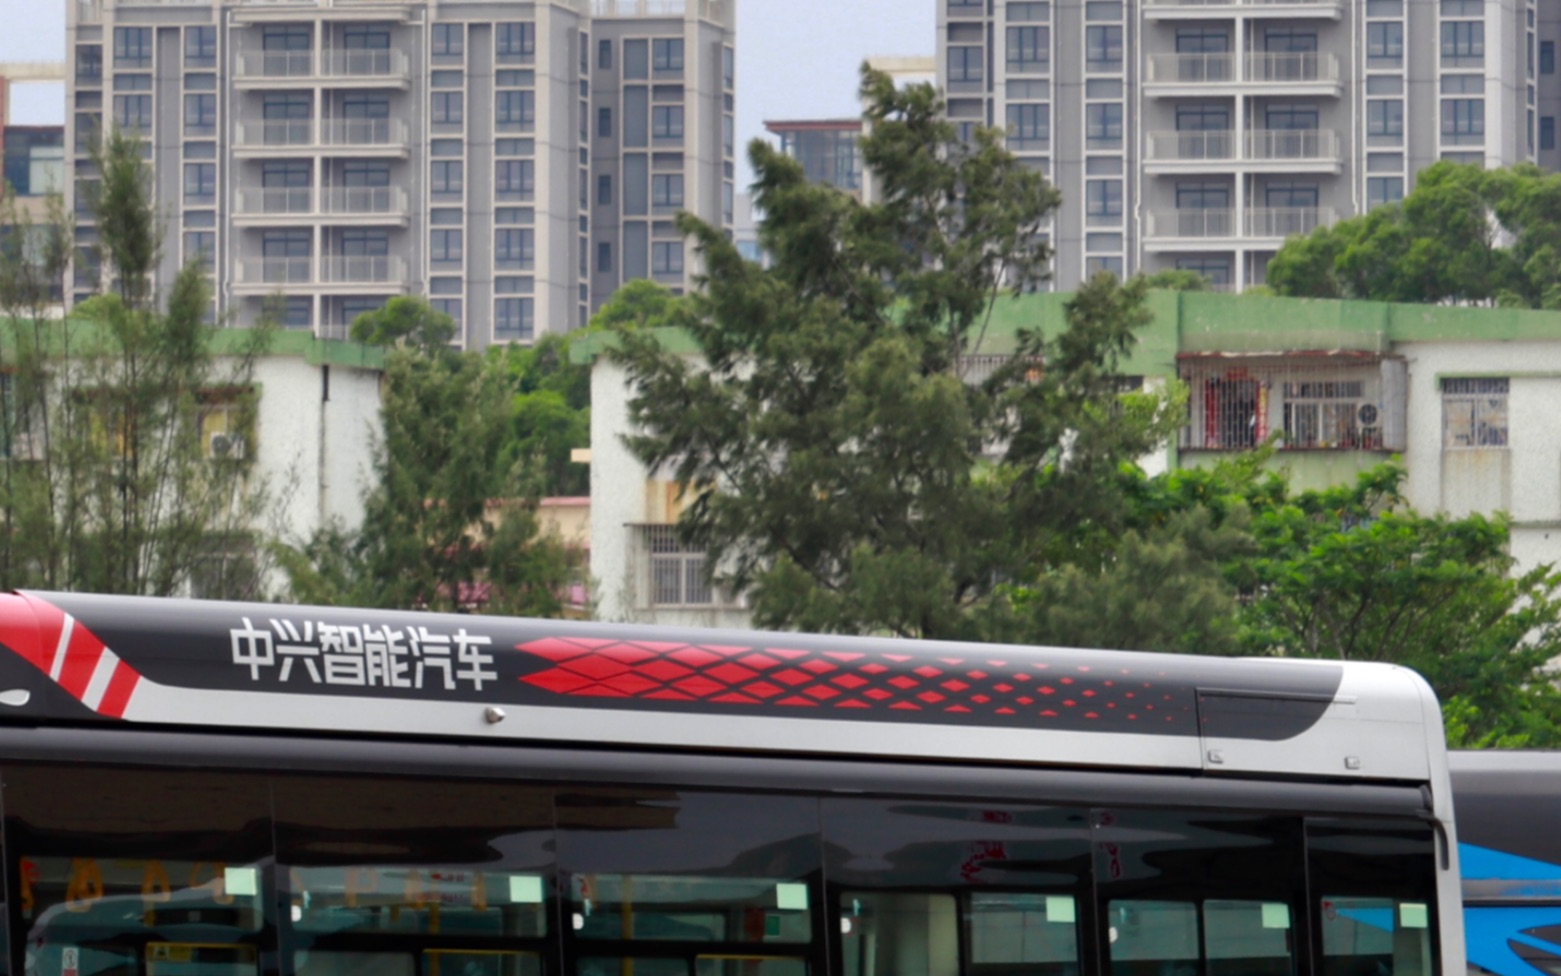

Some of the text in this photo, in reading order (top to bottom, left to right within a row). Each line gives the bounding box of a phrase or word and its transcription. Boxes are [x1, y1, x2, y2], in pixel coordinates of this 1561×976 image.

[230, 617, 497, 691] 中兴智能汽车
